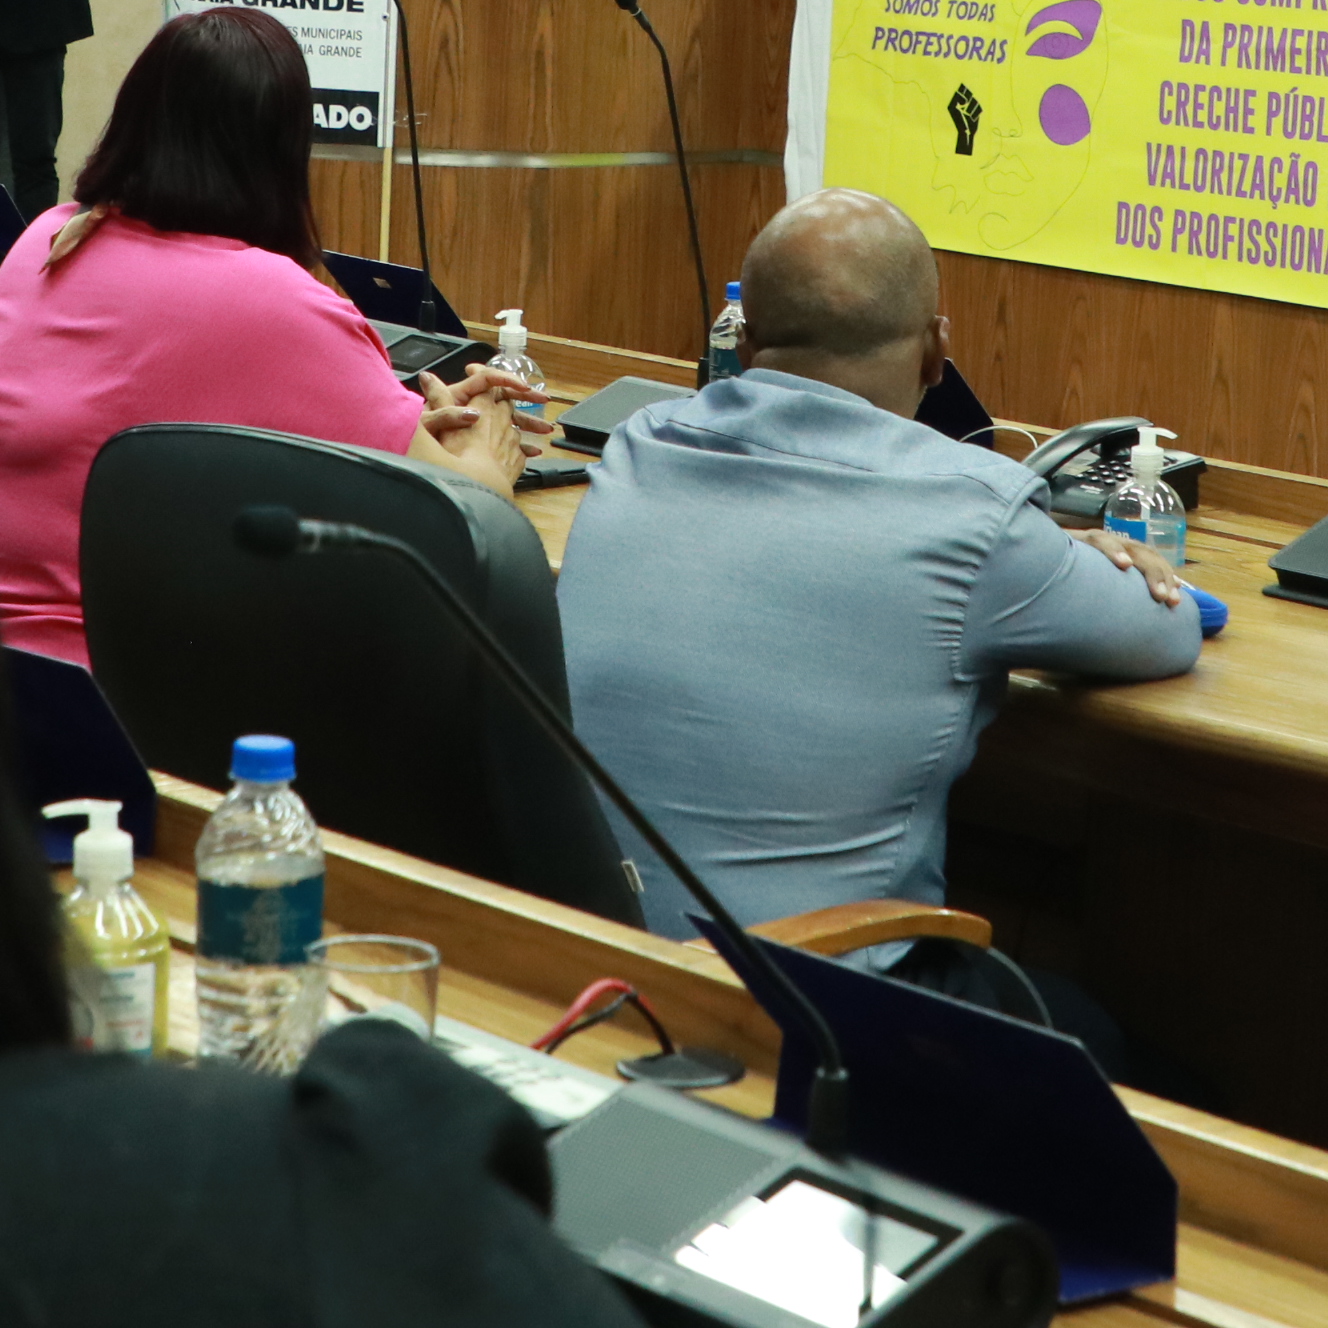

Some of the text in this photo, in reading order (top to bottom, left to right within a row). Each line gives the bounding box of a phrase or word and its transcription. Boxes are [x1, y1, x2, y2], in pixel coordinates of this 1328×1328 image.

[946, 0, 996, 23] TODAS
[301, 27, 363, 41] MUNICIPAIS
[319, 44, 363, 58] GRANDE
[871, 26, 1009, 65] PROFESSORAS
[1179, 18, 1211, 66] DA
[312, 102, 372, 131] ADO
[1158, 79, 1257, 135] CRECHE
[1146, 141, 1319, 210] VALORIZAÇÃO
[1115, 200, 1164, 251] DOS
